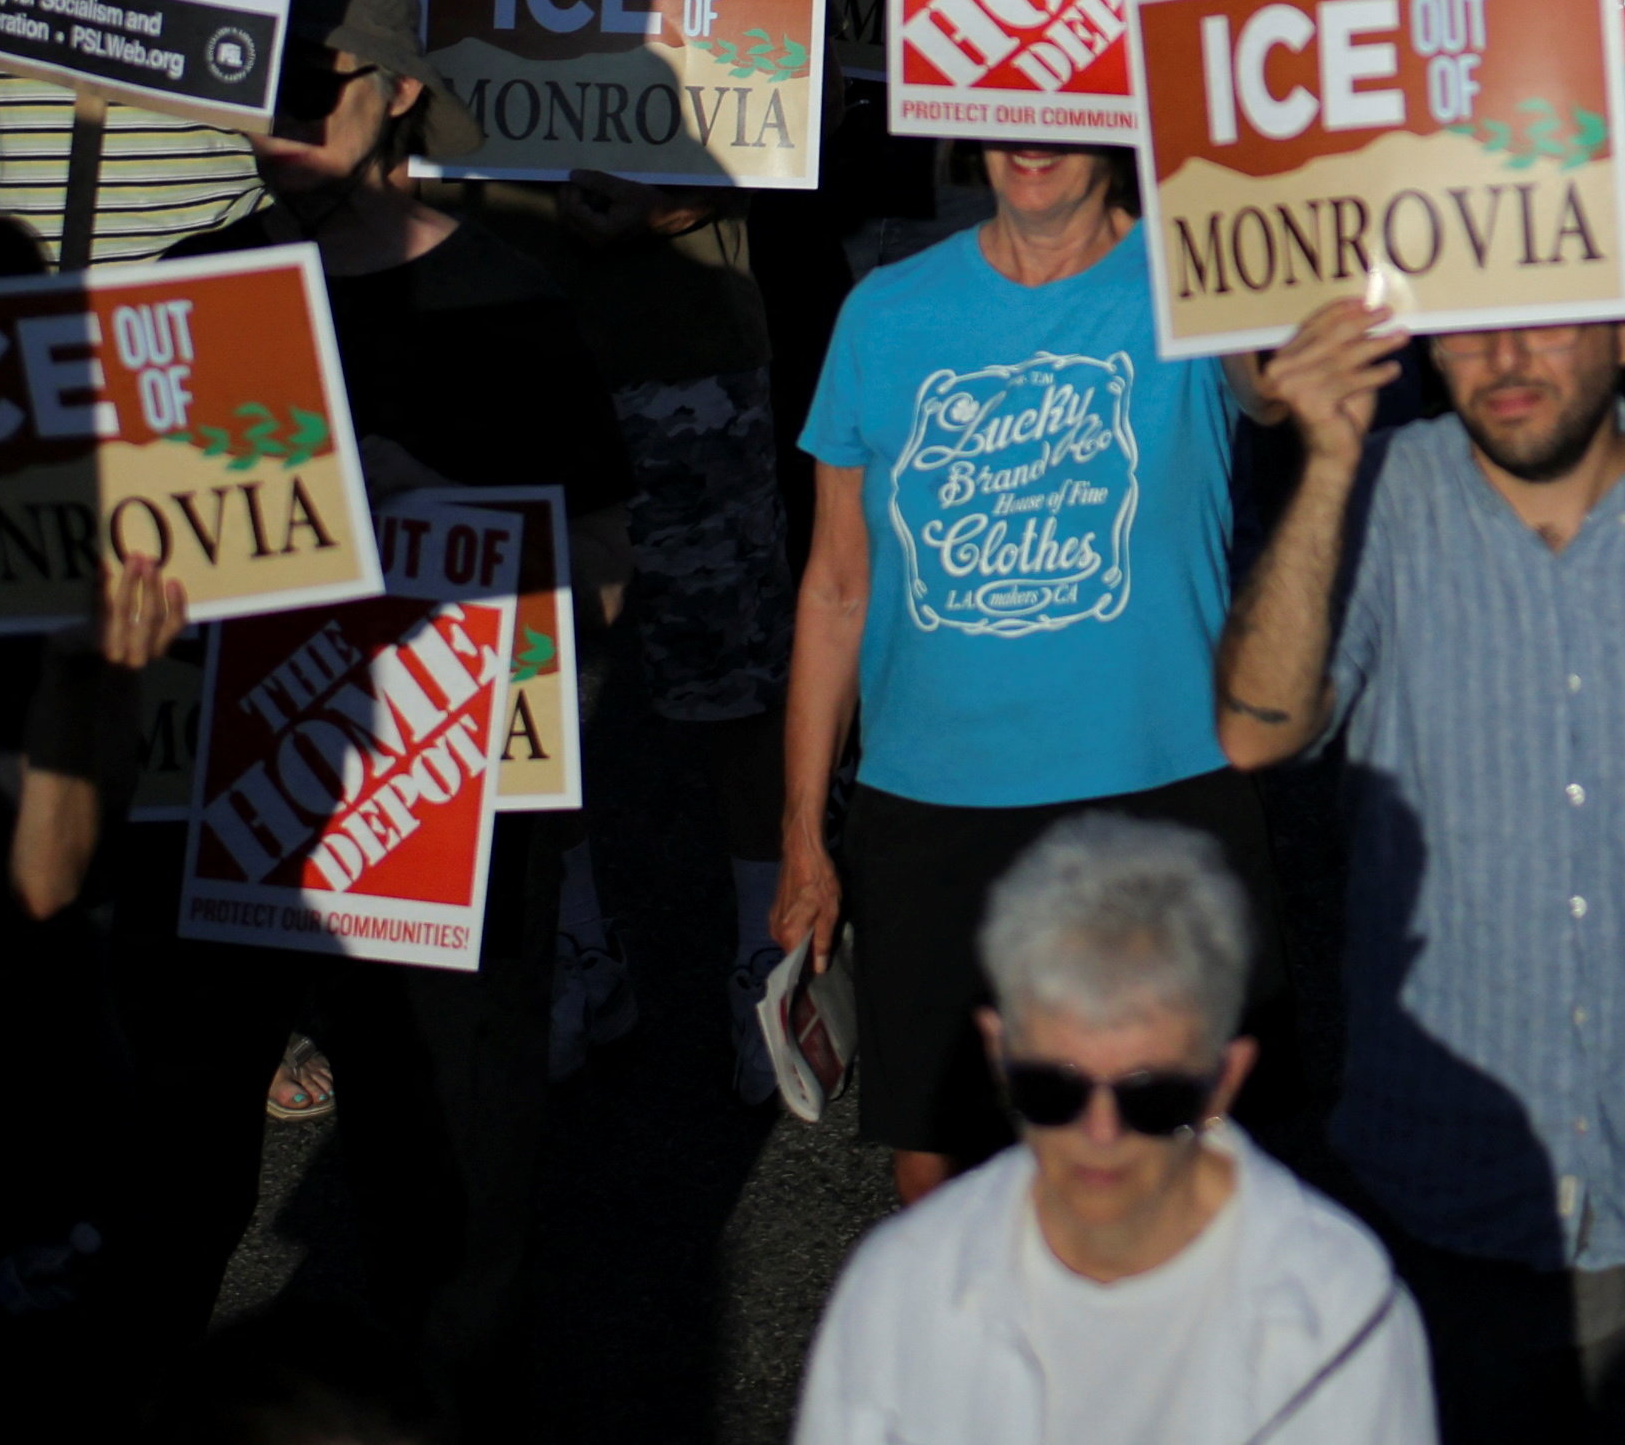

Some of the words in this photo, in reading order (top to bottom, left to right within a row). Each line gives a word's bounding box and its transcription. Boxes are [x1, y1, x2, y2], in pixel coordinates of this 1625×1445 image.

[71, 29, 185, 78] PSLWeb.org
[125, 7, 161, 36] and
[1428, 56, 1481, 122] OF
[1176, 180, 1604, 299] MONROVIA
[913, 384, 1096, 471] Lucky
[938, 441, 1049, 509] Brand
[992, 492, 1042, 516] House
[1046, 478, 1068, 515] of
[1067, 479, 1108, 506] Fine
[922, 512, 1102, 577] Clothes
[989, 585, 1039, 607] makers
